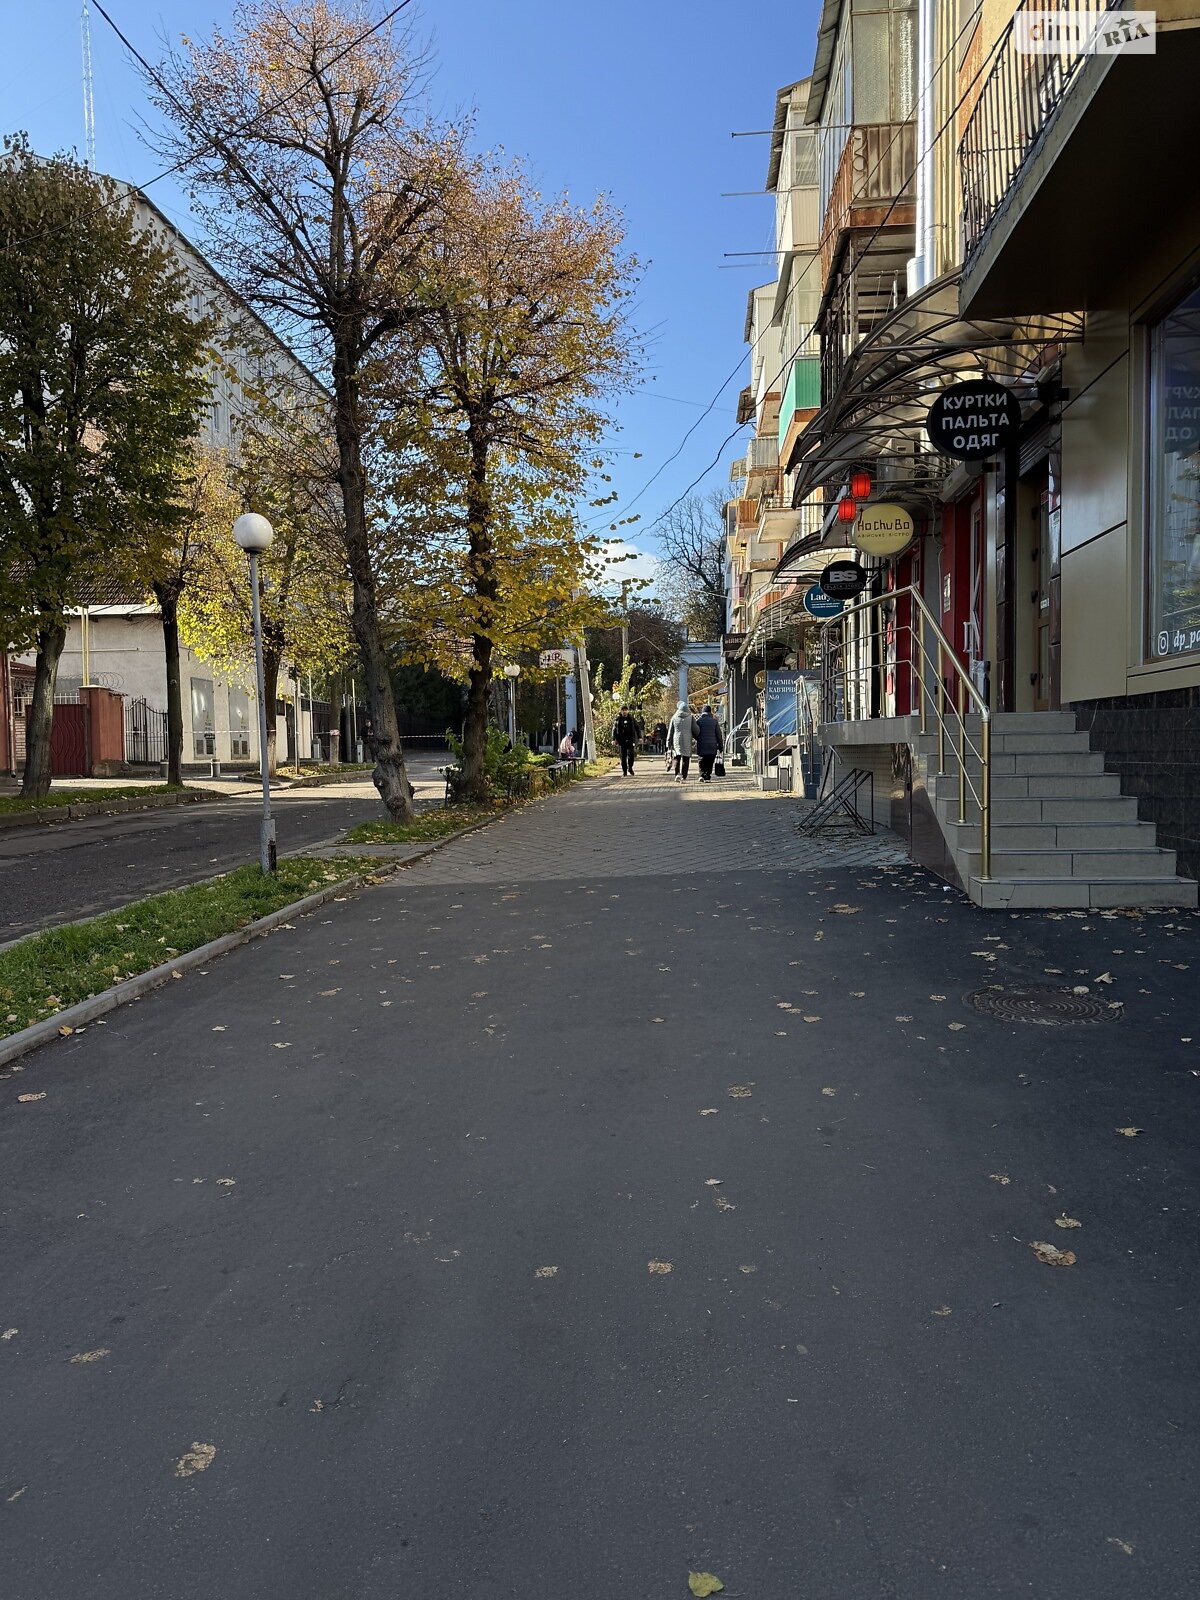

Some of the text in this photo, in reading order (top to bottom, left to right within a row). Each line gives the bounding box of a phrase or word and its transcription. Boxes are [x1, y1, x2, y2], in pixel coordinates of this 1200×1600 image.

[943, 392, 1008, 410] КУРТКИ
[942, 412, 1010, 430] ПАЛЬТА
[953, 433, 999, 451] ОДЯГ
[829, 570, 858, 582] BS
